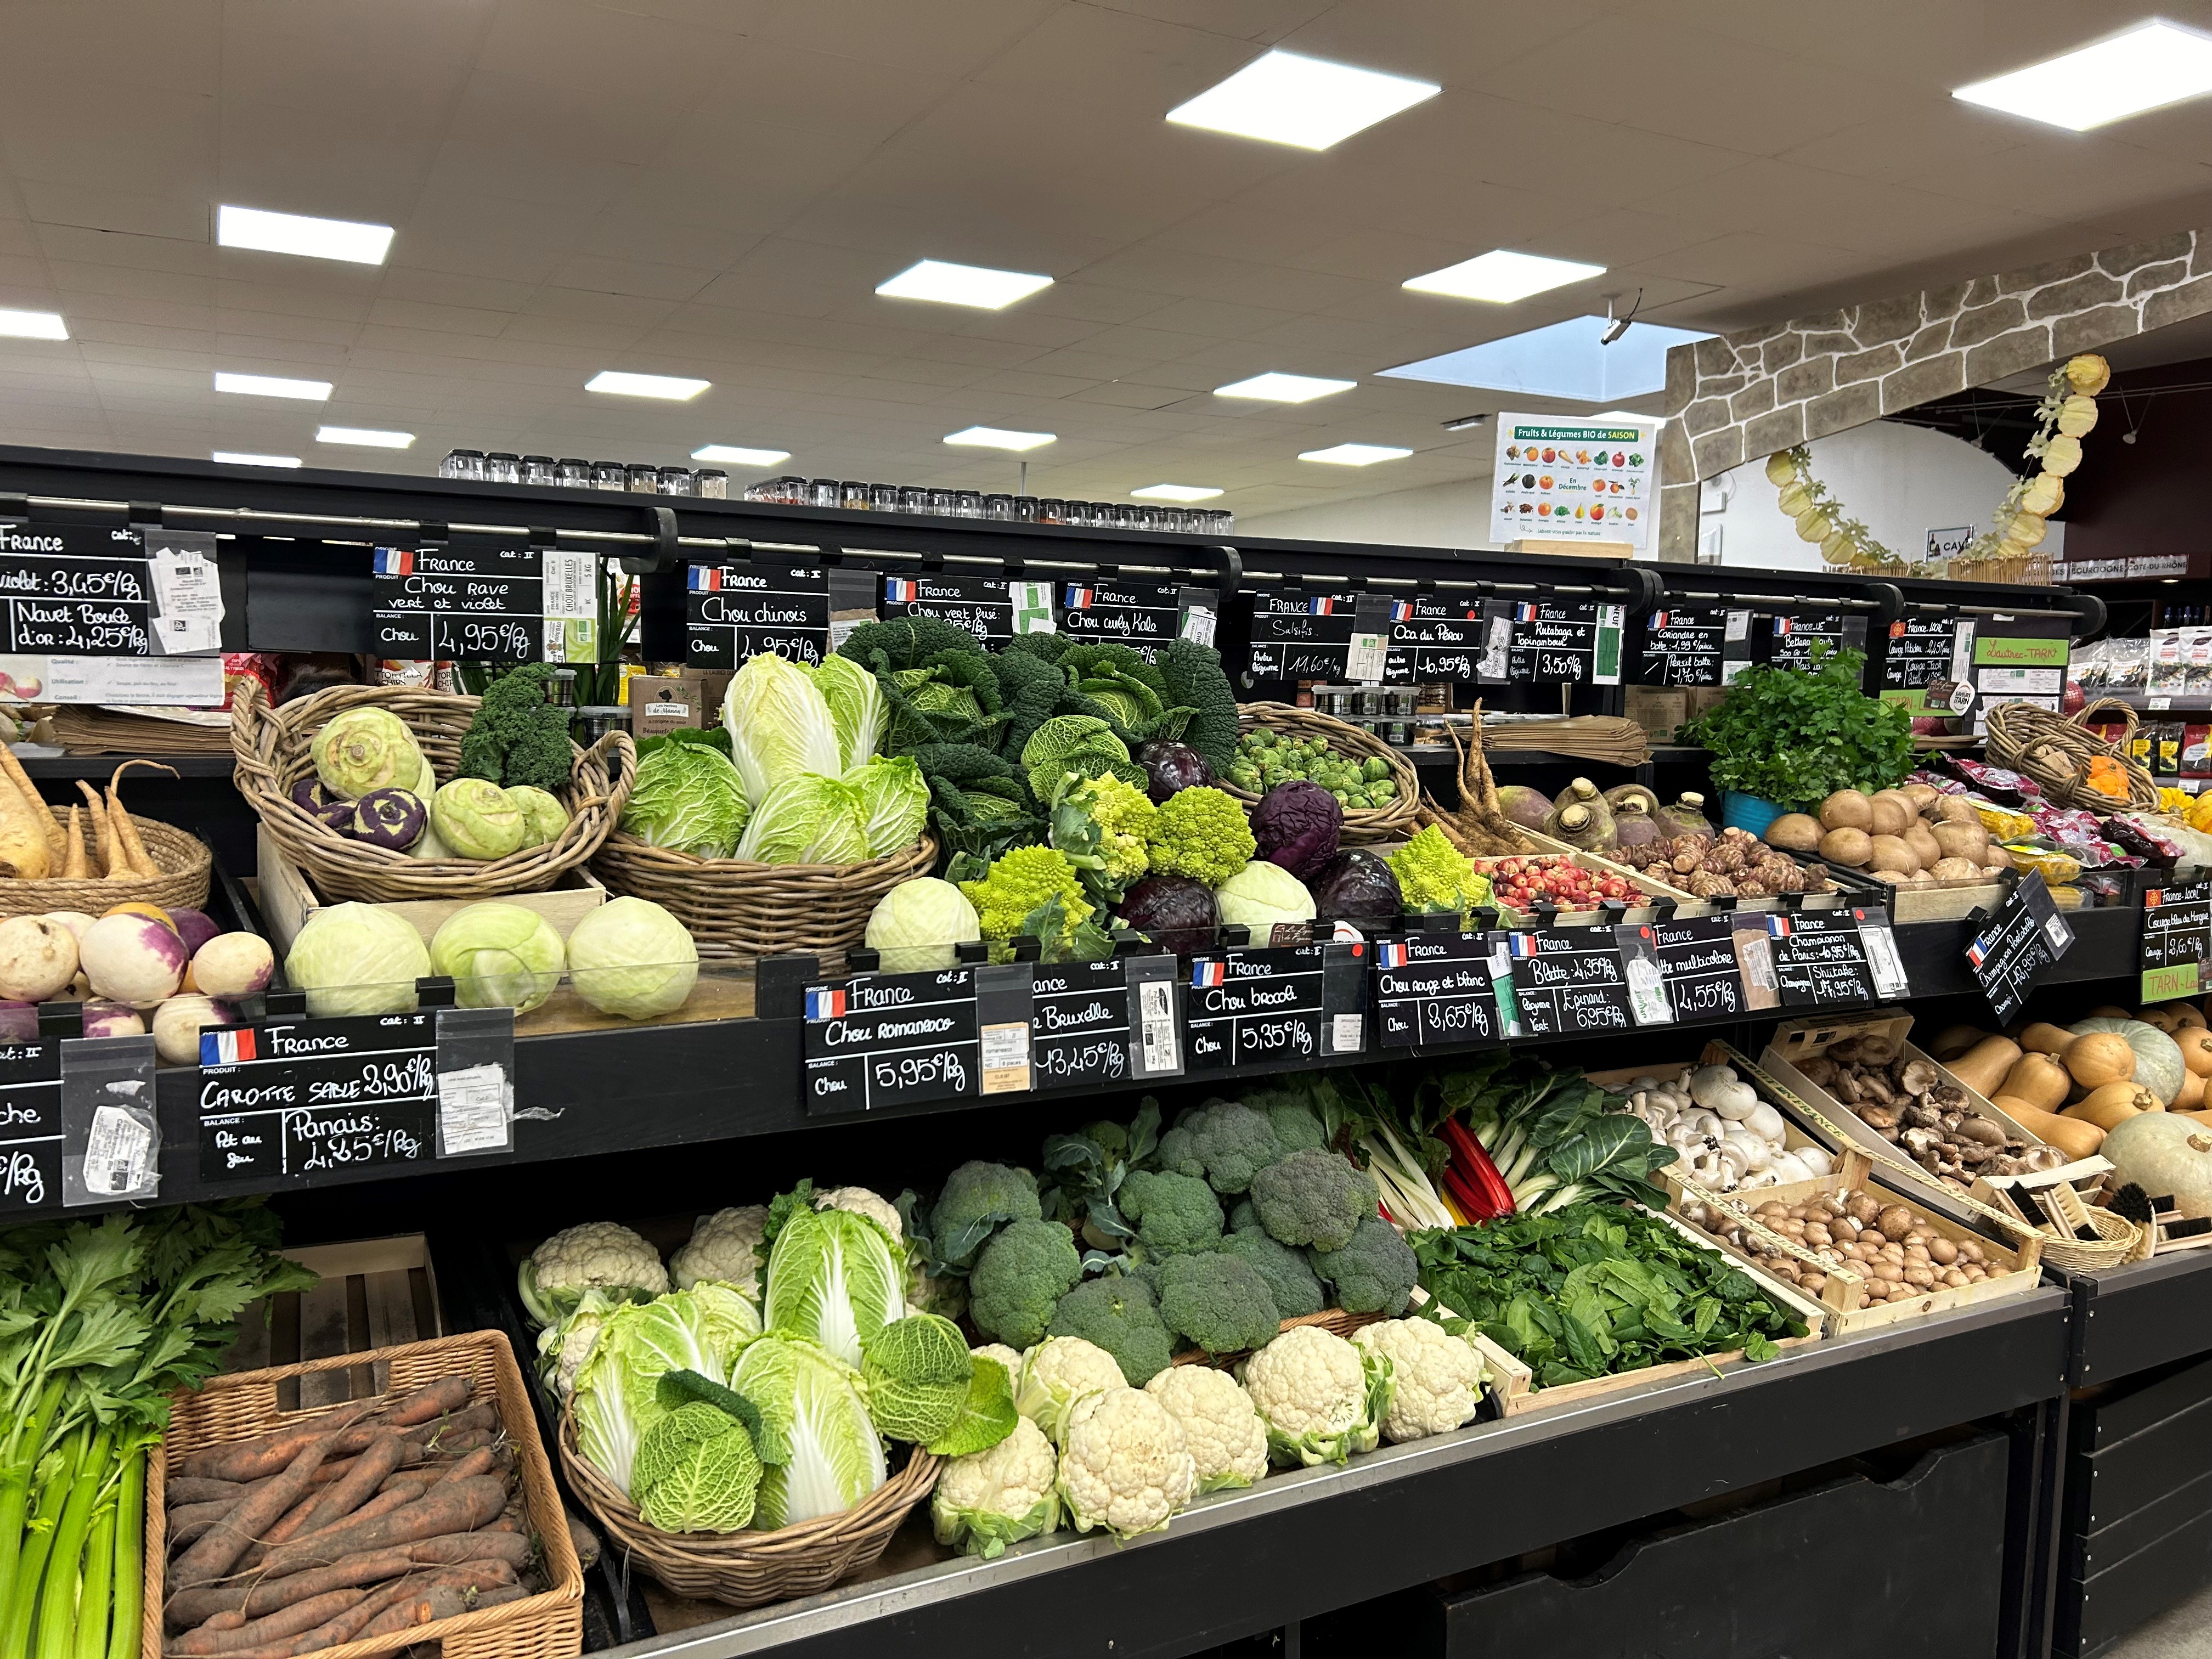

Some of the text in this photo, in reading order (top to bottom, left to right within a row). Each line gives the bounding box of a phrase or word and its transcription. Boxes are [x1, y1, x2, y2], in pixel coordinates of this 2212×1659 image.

[1518, 429, 1539, 437] Fruits
[1549, 430, 1581, 440] Légumes
[0, 524, 64, 551] France
[415, 549, 476, 571] France
[565, 559, 573, 592] BRUXELLES
[717, 566, 767, 588] France
[404, 577, 457, 594] Chou
[916, 579, 961, 597] France
[1093, 584, 1136, 603] France
[17, 601, 132, 624] Navet Boule
[388, 596, 506, 610] vert et violet
[702, 596, 807, 622] Chou chinois
[907, 602, 940, 618] Chou
[945, 608, 970, 619] vert
[1269, 599, 1308, 613] FRANCE
[1415, 599, 1447, 615] France
[1539, 603, 1566, 619] France
[1068, 612, 1158, 636] Chou curly Kale
[1612, 606, 1621, 627] NEUF
[1669, 610, 1694, 625] France
[380, 628, 419, 641] Chou
[1394, 623, 1463, 641] Oca du Pérou
[1515, 633, 1567, 647] Topinambour
[1535, 622, 1585, 640] Rutabaga et
[1657, 628, 1695, 639] Coriandre
[691, 639, 720, 652] Chou
[1669, 654, 1691, 668] Persil
[1791, 913, 1825, 931] France
[2148, 913, 2171, 931] Courge
[2183, 914, 2191, 922] de
[1532, 930, 1573, 951] France
[1654, 924, 1694, 945] France
[1789, 935, 1846, 947] Champignon
[1978, 923, 2002, 948] France
[1405, 936, 1447, 957] France
[1779, 950, 1790, 962] de
[1979, 916, 2035, 988] Champignon Portobello
[2146, 946, 2163, 960] Courge
[1226, 953, 1272, 975] France
[1676, 950, 1734, 972] multicolore
[1032, 979, 1068, 993] ance
[1380, 974, 1410, 994] Chou
[1442, 976, 1454, 989] et
[1456, 970, 1486, 987] blanc
[845, 977, 915, 1009] France
[1205, 985, 1297, 1011] Chou brocoli
[1042, 1002, 1114, 1030] Bruxelle
[1387, 1017, 1409, 1032] Chou
[264, 1015, 425, 1054] France II
[825, 1020, 873, 1046] Chou
[1195, 1036, 1221, 1054] Chou
[200, 1081, 296, 1109] CAROTTE
[308, 1080, 360, 1103] SABLE
[815, 1076, 848, 1096] Chou
[1776, 1086, 1795, 1099] EN
[1793, 1099, 1845, 1138] FRANCE
[215, 1131, 238, 1149] Pot
[242, 1136, 262, 1145] au
[226, 1152, 254, 1169] feu
[1957, 1195, 2023, 1227] FRANCE
[1769, 1234, 1841, 1273] PRODUIT
